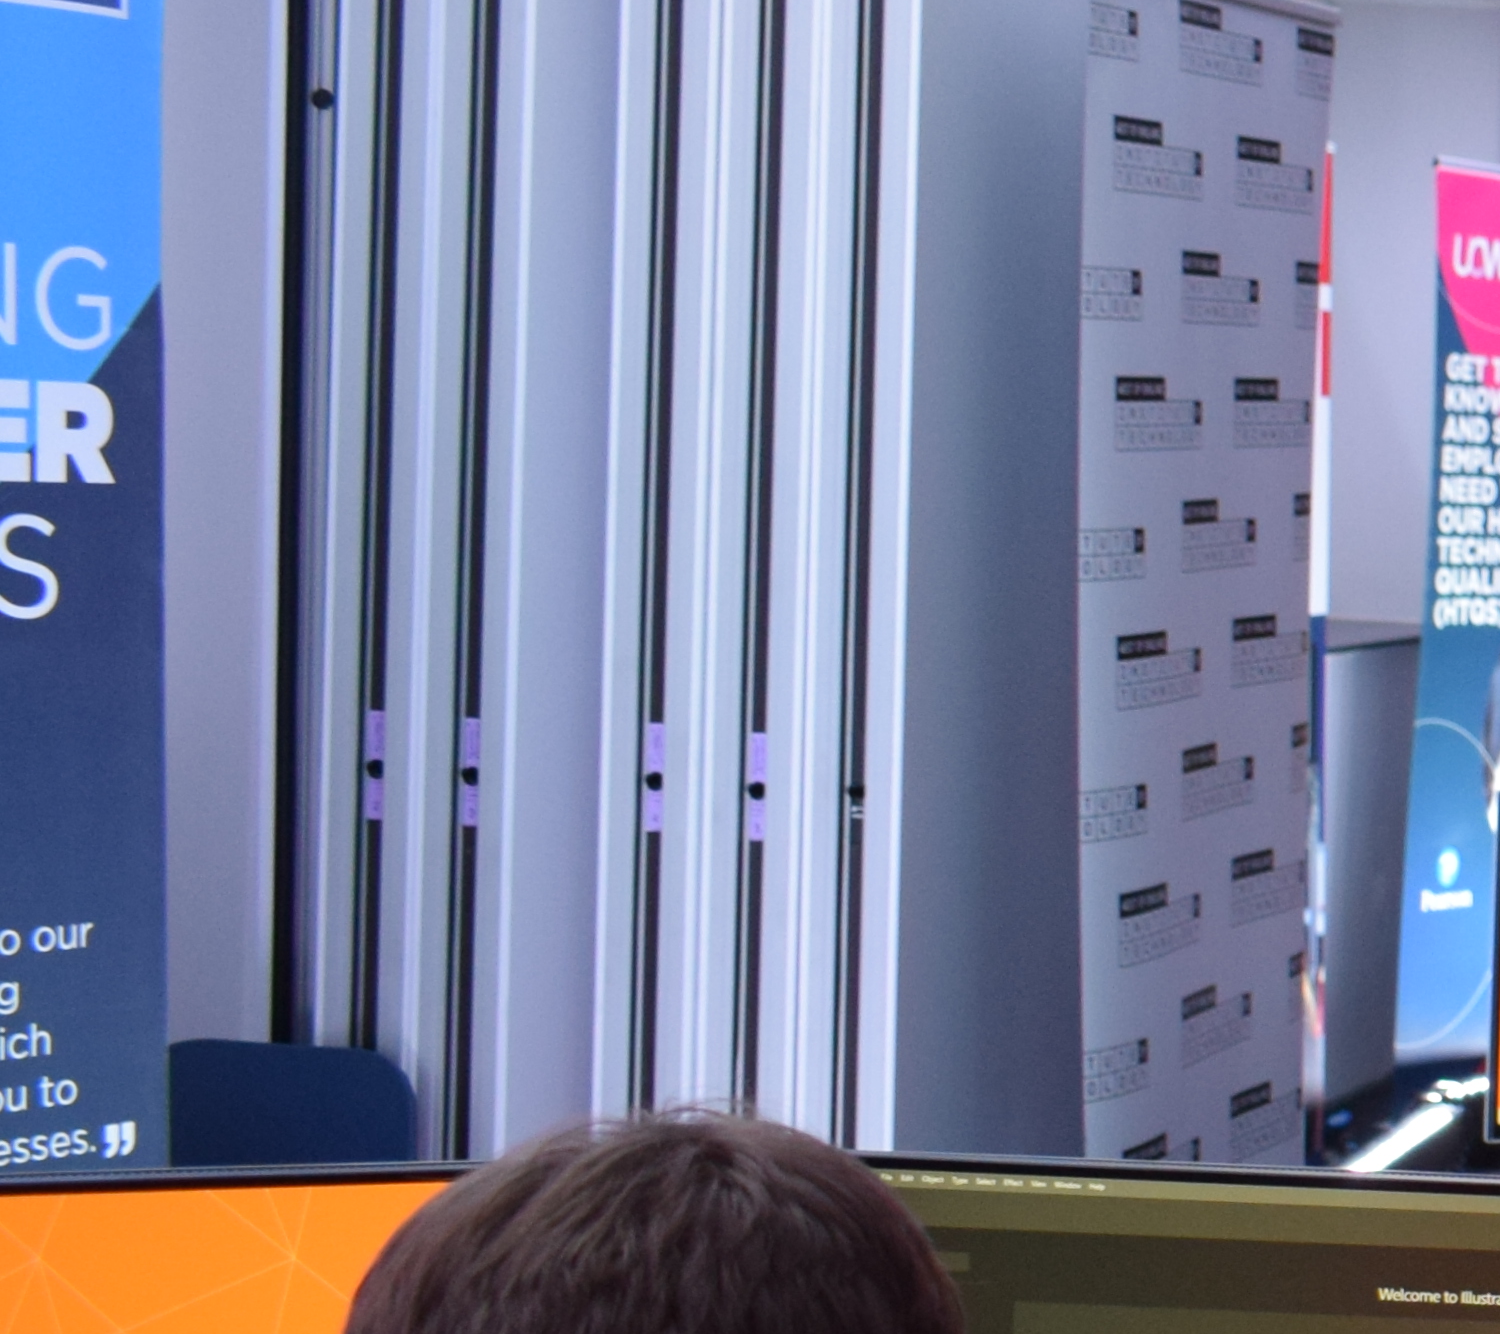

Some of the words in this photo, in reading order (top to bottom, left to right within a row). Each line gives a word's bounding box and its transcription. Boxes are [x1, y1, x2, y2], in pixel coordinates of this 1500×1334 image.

[1445, 352, 1488, 383] GET
[1442, 414, 1490, 444] AND
[1439, 475, 1498, 505] NEED
[1437, 505, 1486, 535] OUR
[32, 922, 94, 952] our
[40, 1076, 78, 1108] to
[1377, 1287, 1441, 1304] Welcome
[1443, 1291, 1458, 1304] to
